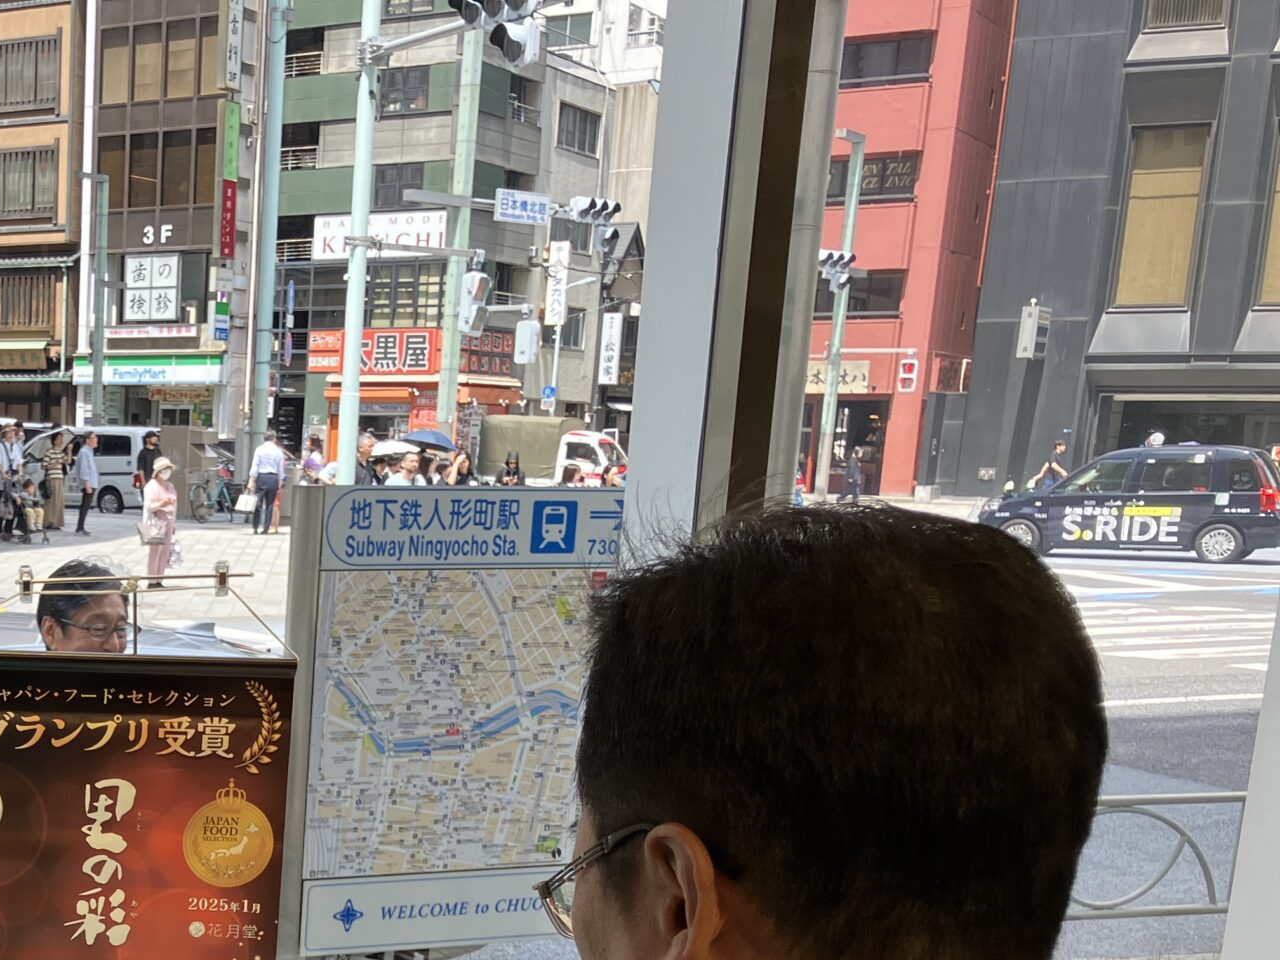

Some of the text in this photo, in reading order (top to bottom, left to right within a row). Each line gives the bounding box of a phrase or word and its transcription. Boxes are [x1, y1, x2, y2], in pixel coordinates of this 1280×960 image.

[388, 214, 444, 225] MODE
[142, 224, 173, 245] 3F
[112, 367, 167, 383] FamilyMart
[349, 498, 521, 531] 地下鉄人形町駅
[1062, 514, 1181, 543] S.RIDE
[345, 534, 406, 561] Subway
[409, 533, 488, 561] Ningyocho
[492, 534, 520, 556] Sta.
[203, 815, 240, 826] JAPAN
[203, 826, 239, 836] FOOD
[63, 777, 137, 947] 里の彩
[188, 897, 262, 914] 2025年1月
[380, 900, 469, 920] WELCOME
[475, 902, 489, 915] to
[206, 922, 258, 939] 花月堂
